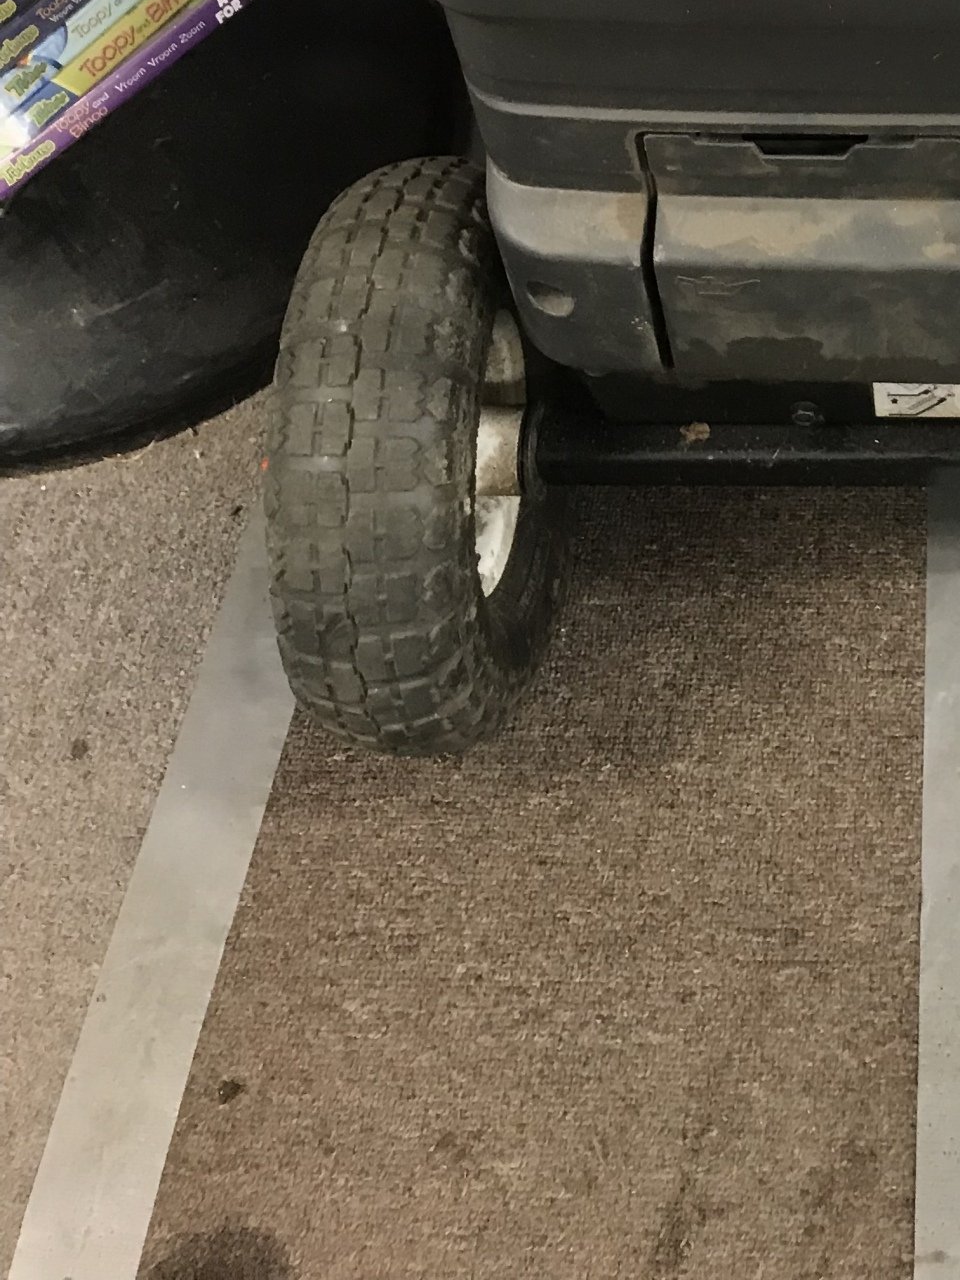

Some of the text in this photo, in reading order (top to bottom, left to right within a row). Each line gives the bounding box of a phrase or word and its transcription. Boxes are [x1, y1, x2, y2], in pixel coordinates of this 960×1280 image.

[71, 2, 114, 38] Toopy
[80, 24, 137, 77] Toopy
[115, 20, 206, 93] Vroom Vroom Zoom
[92, 92, 110, 109] and
[70, 106, 109, 139] Binoo
